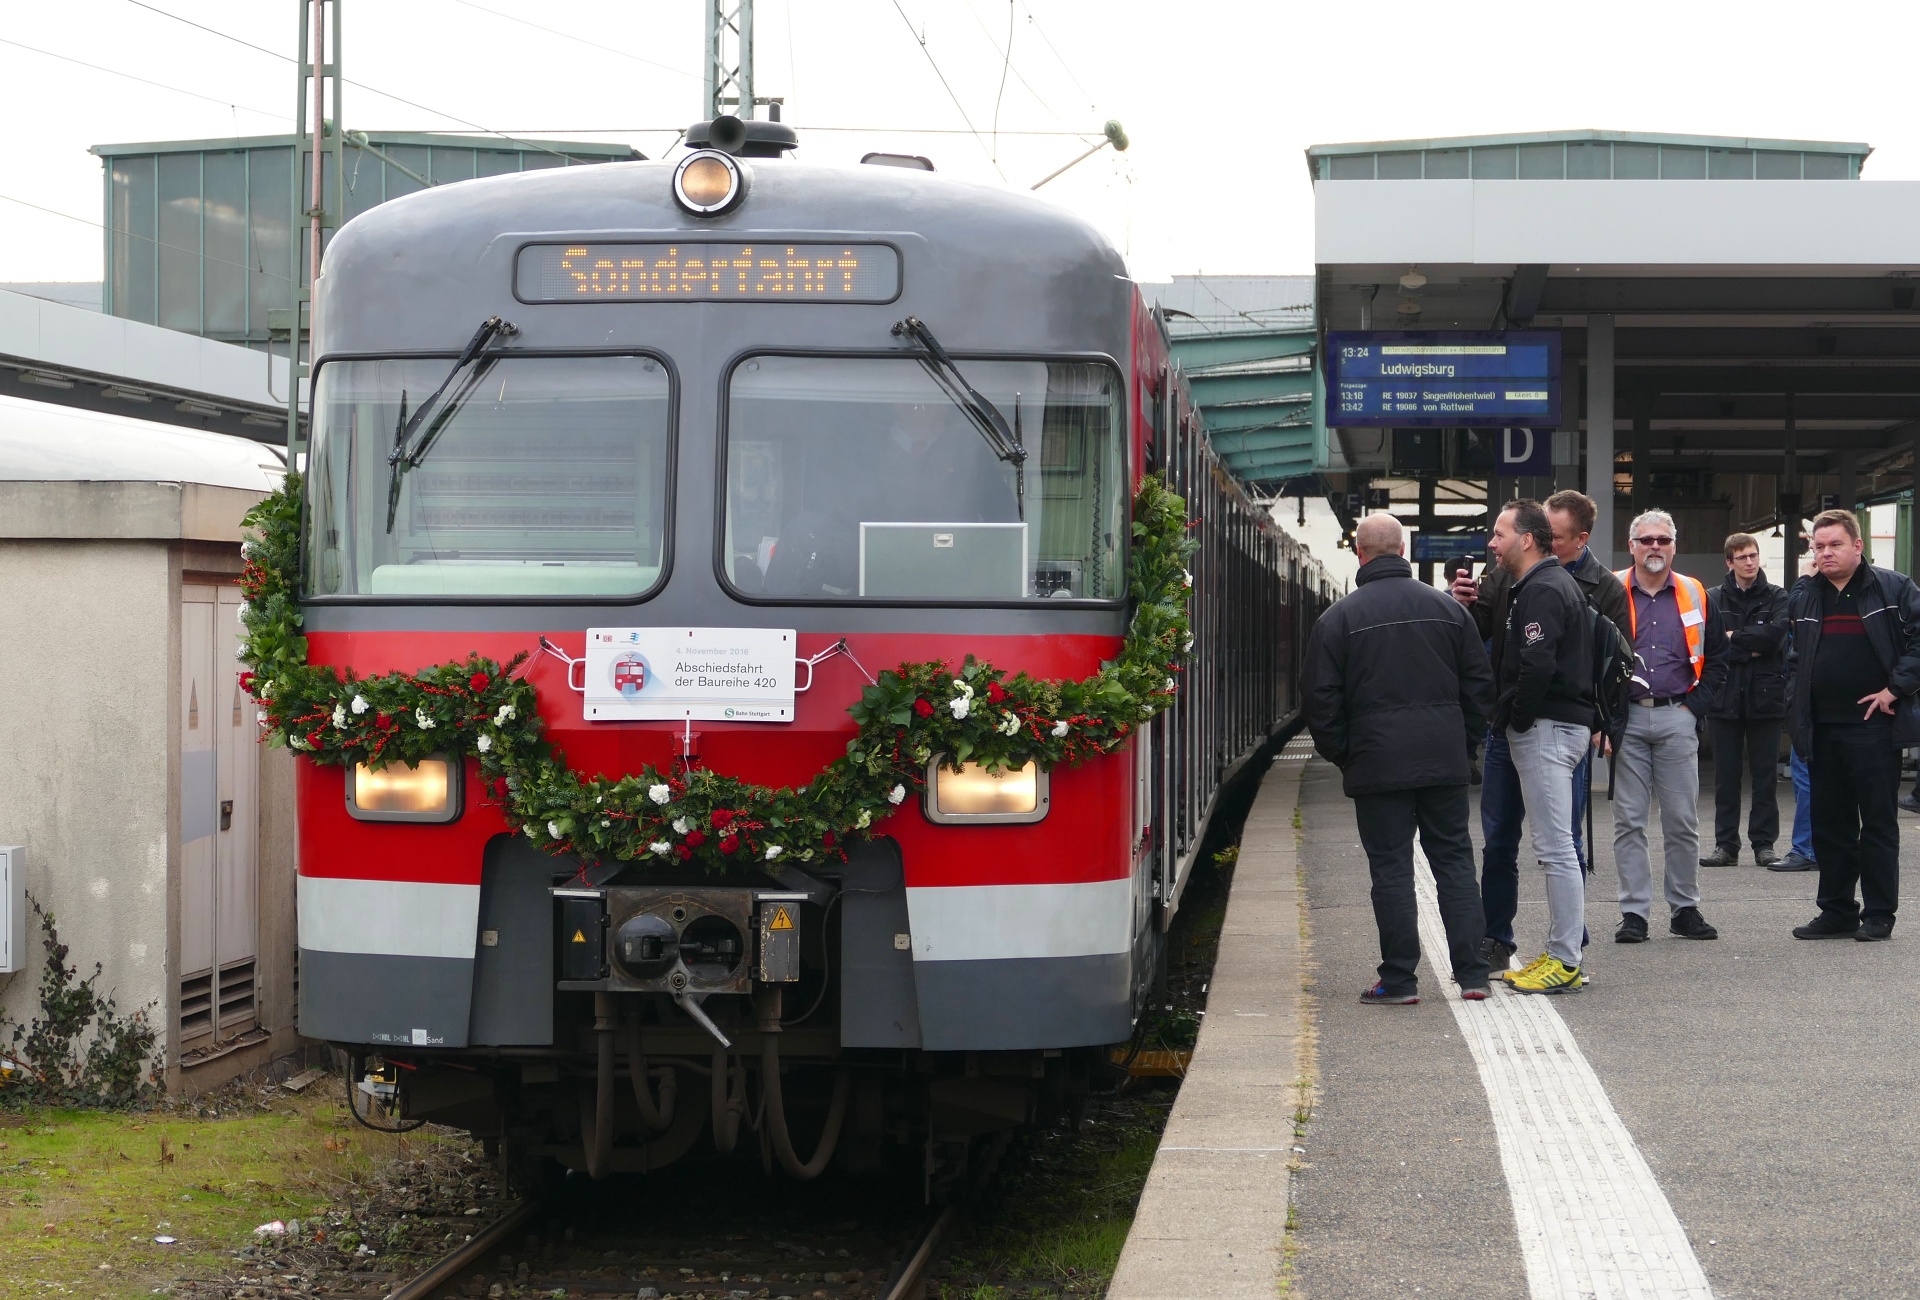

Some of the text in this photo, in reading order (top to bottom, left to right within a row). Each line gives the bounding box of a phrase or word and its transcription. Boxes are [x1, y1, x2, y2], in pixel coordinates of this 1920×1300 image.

[562, 248, 857, 292] Sonderfahrt
[1342, 347, 1369, 358] 13:24
[1381, 363, 1455, 377] Ludwigsburg
[1341, 391, 1364, 400] 13:18
[1382, 392, 1392, 400] RE
[1395, 392, 1418, 400] 19037
[1341, 402, 1475, 412] 13:42 RE 19086 von Rottweil
[1503, 428, 1534, 464] D
[1371, 489, 1382, 505] 4
[675, 647, 749, 656] 4. November 2016
[675, 662, 763, 674] Abschiedsfahrt
[674, 676, 777, 688] der Baureihe 420
[749, 710, 771, 718] Stuttgart
[426, 1036, 444, 1044] Sand
